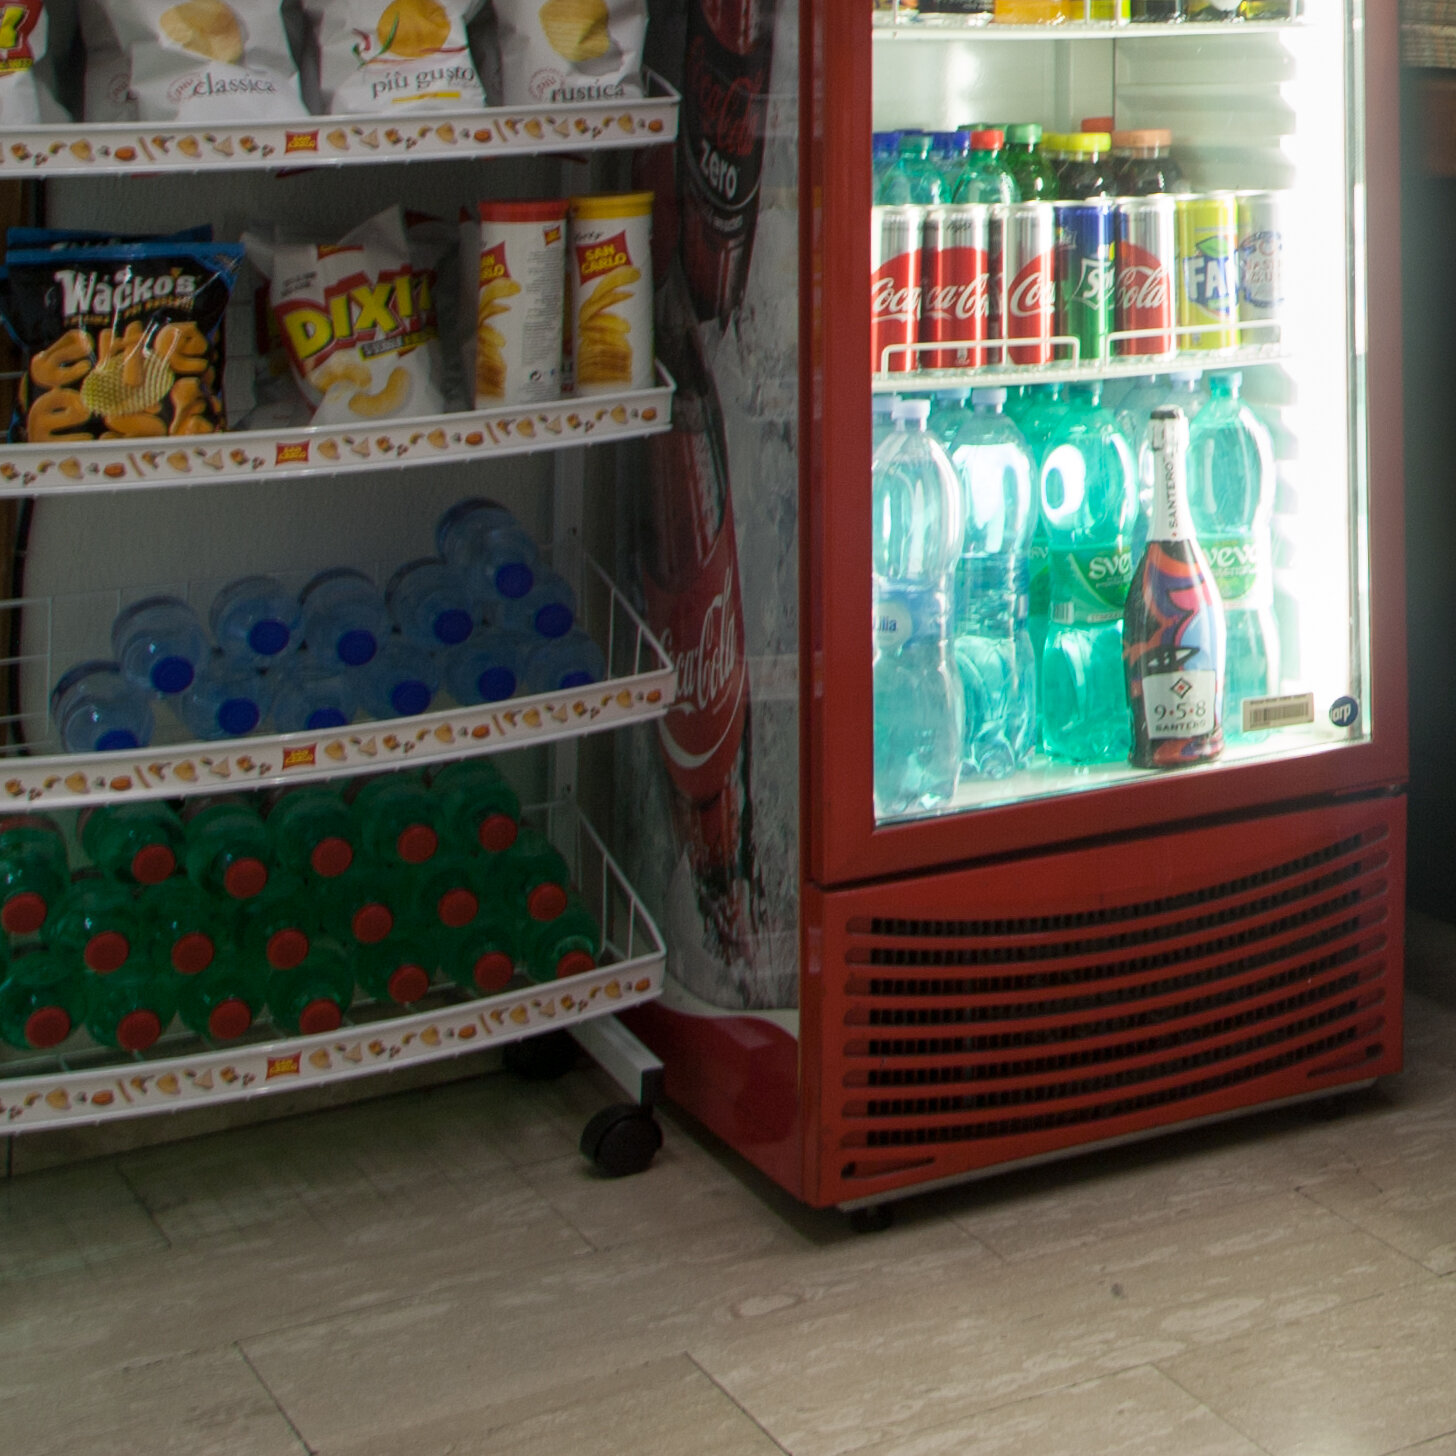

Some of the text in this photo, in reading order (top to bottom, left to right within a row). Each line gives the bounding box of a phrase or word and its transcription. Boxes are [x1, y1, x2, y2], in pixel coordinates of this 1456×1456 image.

[192, 73, 277, 96] classica
[371, 65, 475, 99] più gusto
[551, 81, 626, 103] rustica
[585, 243, 617, 262] SAN
[581, 253, 627, 276] CARLO
[1167, 460, 1181, 530] SANTERO
[1154, 720, 1208, 733] SANTERO
